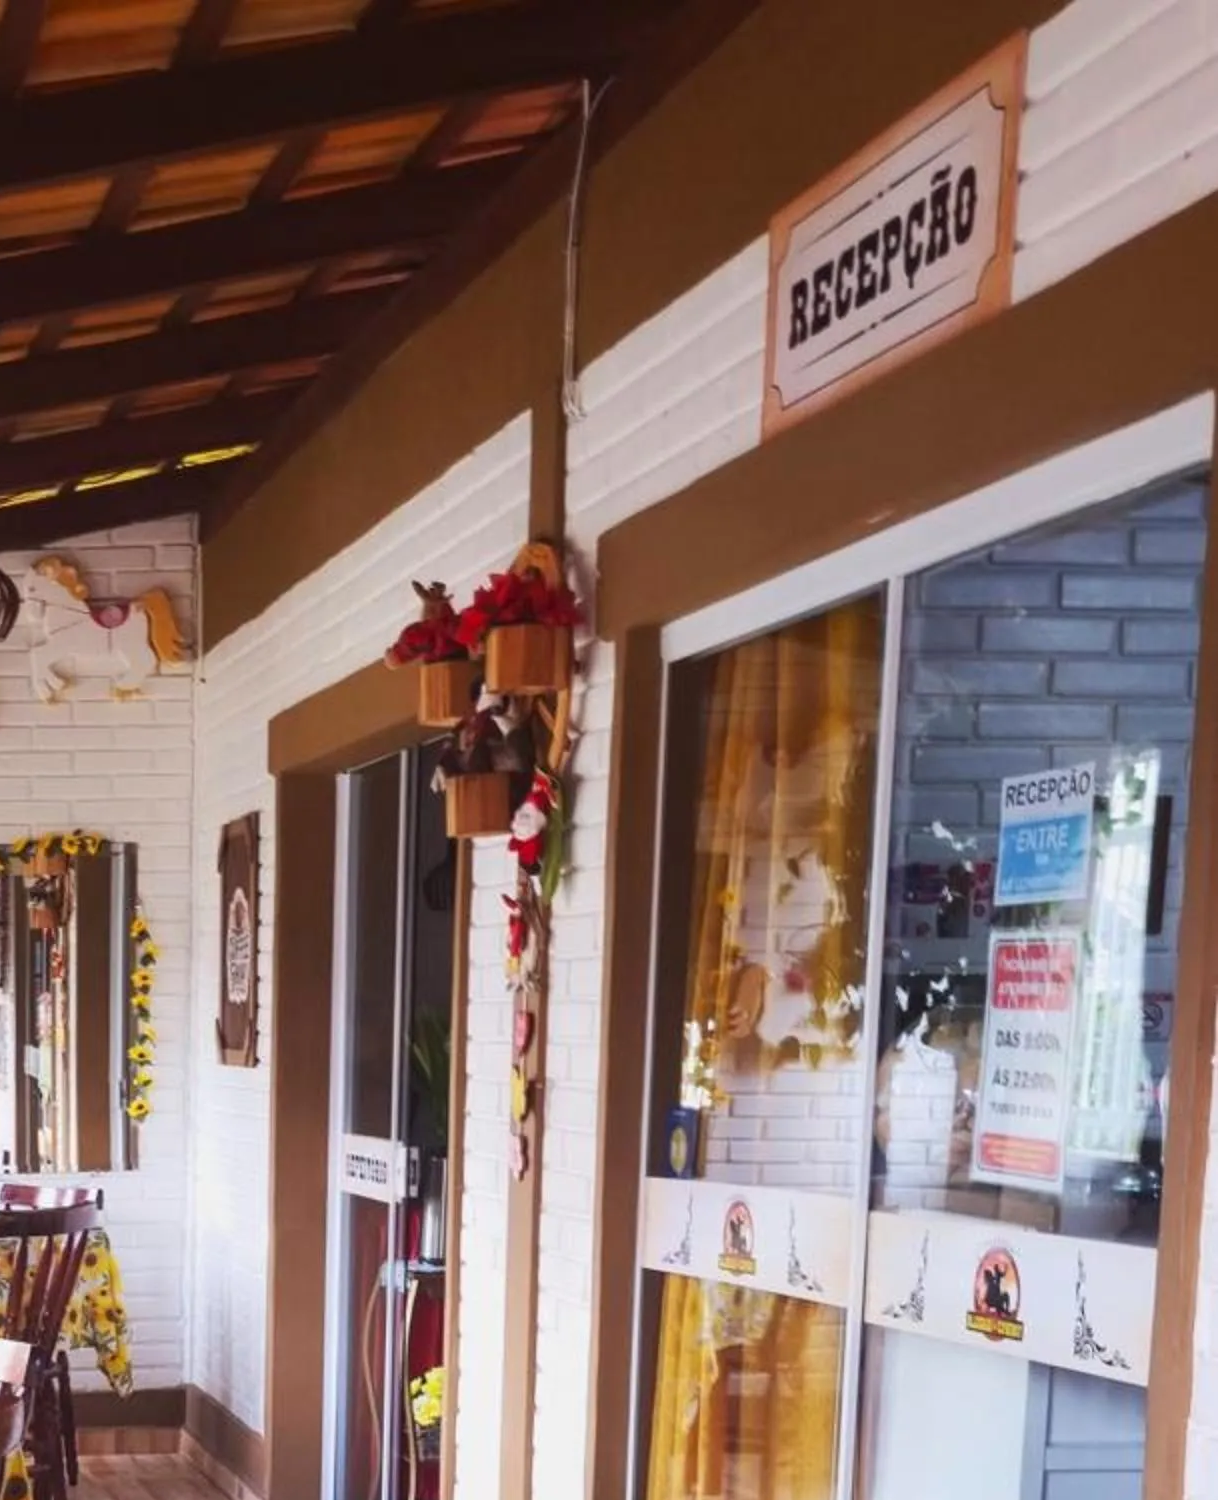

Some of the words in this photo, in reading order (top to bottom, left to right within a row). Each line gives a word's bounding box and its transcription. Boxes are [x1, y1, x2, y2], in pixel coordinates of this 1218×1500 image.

[788, 164, 977, 350] RECEPÇÃO
[1005, 768, 1091, 809] RECEPÇÃO
[1016, 822, 1069, 854] ENTRE
